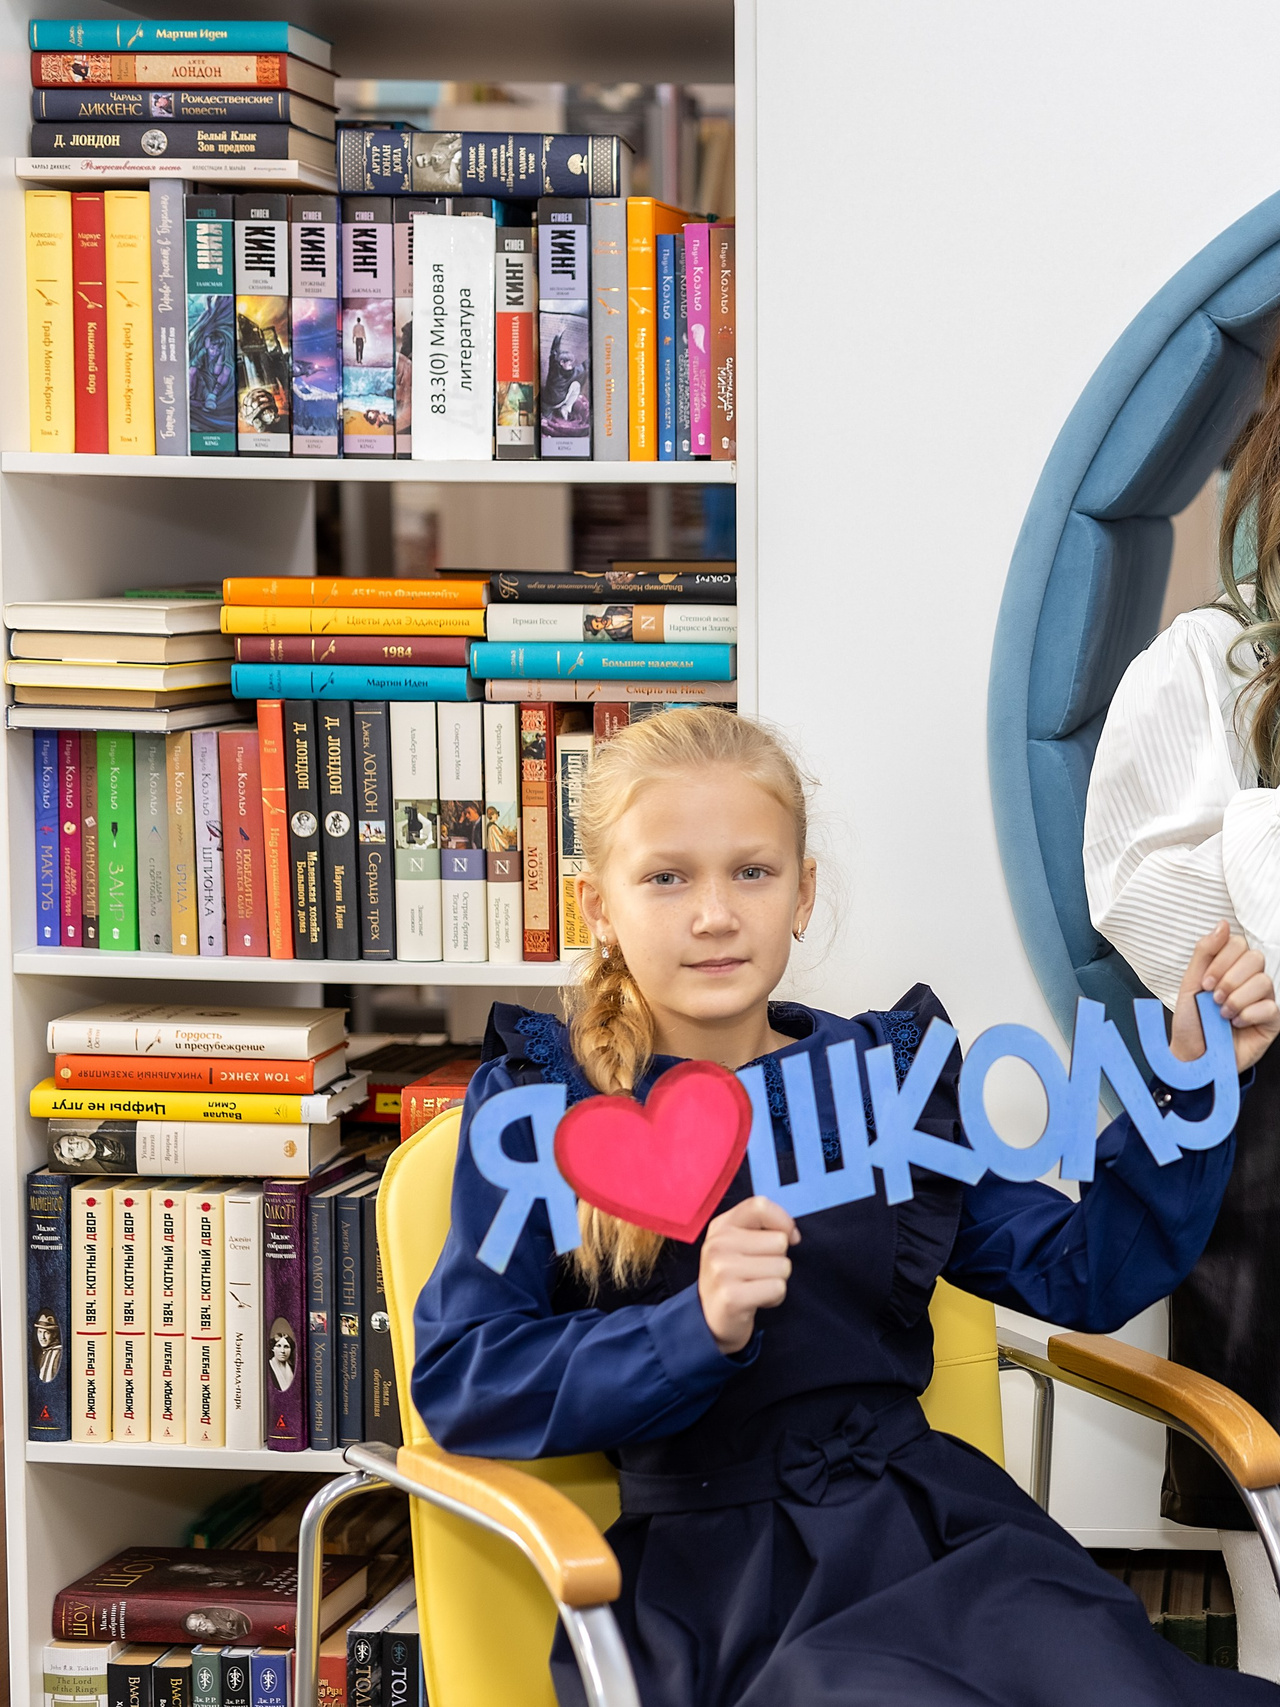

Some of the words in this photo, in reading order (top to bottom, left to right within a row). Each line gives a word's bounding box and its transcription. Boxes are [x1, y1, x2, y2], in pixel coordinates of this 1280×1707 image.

[156, 29, 197, 40] Мартин
[200, 29, 227, 39] Иден
[171, 66, 222, 78] ЛОНДОН
[79, 103, 143, 116] ДИККЕНС
[181, 93, 273, 104] Рождественские
[182, 106, 227, 115] повести
[54, 135, 66, 148] Д.
[70, 135, 120, 148] ЛОНДОН
[197, 131, 227, 141] Белый
[231, 132, 257, 142] Клык
[197, 142, 215, 152] Зов
[218, 143, 255, 154] предков
[372, 146, 380, 175] АРТУР
[382, 144, 391, 177] КОНАН
[77, 232, 101, 242] Маркус
[80, 240, 98, 248] Зусак
[245, 226, 275, 277] КИНГ
[300, 227, 325, 277] КИНГ
[352, 228, 377, 278] КИНГ
[551, 229, 576, 280] КИНГ
[719, 243, 729, 267] Пауло
[506, 258, 524, 306] КИНГ
[431, 263, 449, 346] Мировая
[42, 320, 53, 346] Граф
[87, 321, 98, 374] Книжный
[123, 323, 134, 349] Граф
[459, 288, 475, 391] литература
[636, 328, 646, 348] Над
[43, 349, 53, 422] Монте-Кристо
[85, 377, 96, 395] вор
[123, 352, 133, 424] Монте-Кристо
[430, 351, 448, 415] 83.3(0)
[717, 366, 727, 411] МИНУТ
[346, 614, 380, 628] Цветы
[382, 615, 403, 627] для
[405, 616, 470, 629] Элджернона
[512, 617, 538, 627] Герман
[540, 617, 558, 626] Гессе
[382, 646, 413, 659] 1984
[602, 658, 645, 670] Большие
[648, 658, 694, 672] надежды
[366, 677, 402, 690] Мартин
[405, 678, 428, 689] Иден
[293, 722, 306, 735] Д.
[324, 716, 339, 732] Д.
[295, 739, 309, 790] ЛОНДОН
[327, 736, 342, 795] ЛОНДОН
[363, 751, 378, 813] ЛОНДОН
[85, 835, 97, 921] МАНУСКРИПТ
[202, 847, 214, 916] ШПИОНКА
[242, 848, 253, 918] ПОБЕДИТЕЛЬ
[296, 861, 307, 907] Большого
[307, 851, 318, 903] Маленькая
[333, 865, 344, 901] Мартин
[367, 852, 382, 904] Сердца
[527, 846, 538, 891] МОЭМ
[108, 861, 125, 921] ЗАИР
[176, 864, 188, 913] БРИДА
[335, 905, 345, 929] Иден
[462, 892, 470, 919] Острие
[297, 910, 306, 933] дома
[309, 906, 320, 943] хозяйка
[369, 909, 380, 940] трех
[461, 919, 471, 951] бритвы
[175, 1030, 222, 1040] Гордость
[185, 1042, 266, 1053] предубеждение
[78, 1069, 135, 1079] ЭКЗЕМПЛЯР
[138, 1070, 202, 1080] УНИКАЛЬНЫЙ
[221, 1072, 259, 1081] ХЭНКС
[264, 1073, 290, 1082] ТОМ
[52, 1100, 83, 1111] лгут
[88, 1101, 104, 1112] не
[110, 1102, 165, 1115] Цифры
[203, 1111, 242, 1120] Вацлав
[208, 1101, 236, 1109] Смил
[469, 1082, 582, 1275] Я
[734, 990, 1242, 1218] ШКОЛУ
[85, 1211, 98, 1241] ДВОР
[123, 1211, 136, 1241] ДВОР
[162, 1213, 175, 1242] ДВОР
[200, 1216, 213, 1246] ДВОР
[84, 1244, 97, 1296] СКОТНЫЙ
[122, 1244, 135, 1296] СКОТНЫЙ
[161, 1245, 174, 1298] СКОТНЫЙ
[199, 1249, 212, 1301] СКОТНЫЙ
[312, 1256, 324, 1304] ОЛКОТТ
[342, 1257, 355, 1306] ОСТЕН
[85, 1299, 97, 1326] 1984.
[123, 1299, 135, 1326] 1984.
[162, 1301, 174, 1327] 1984.
[200, 1304, 212, 1331] 1984.
[85, 1340, 97, 1376] ОРУЭЛЛ
[123, 1340, 135, 1376] ОРУЭЛЛ
[162, 1341, 174, 1377] ОРУЭЛЛ
[200, 1345, 212, 1381] ОРУЭЛЛ
[233, 1332, 243, 1410] Мэнсфилд-парк
[313, 1342, 325, 1396] Хорошие
[85, 1379, 97, 1419] ДЖОРДЖ
[123, 1379, 135, 1419] ДЖОРДЖ
[162, 1380, 174, 1421] ДЖОРДЖ
[200, 1384, 212, 1425] ДЖОРДЖ
[314, 1400, 325, 1431] жены
[73, 1601, 90, 1636] ШОУ
[75, 1685, 97, 1694] Rings
